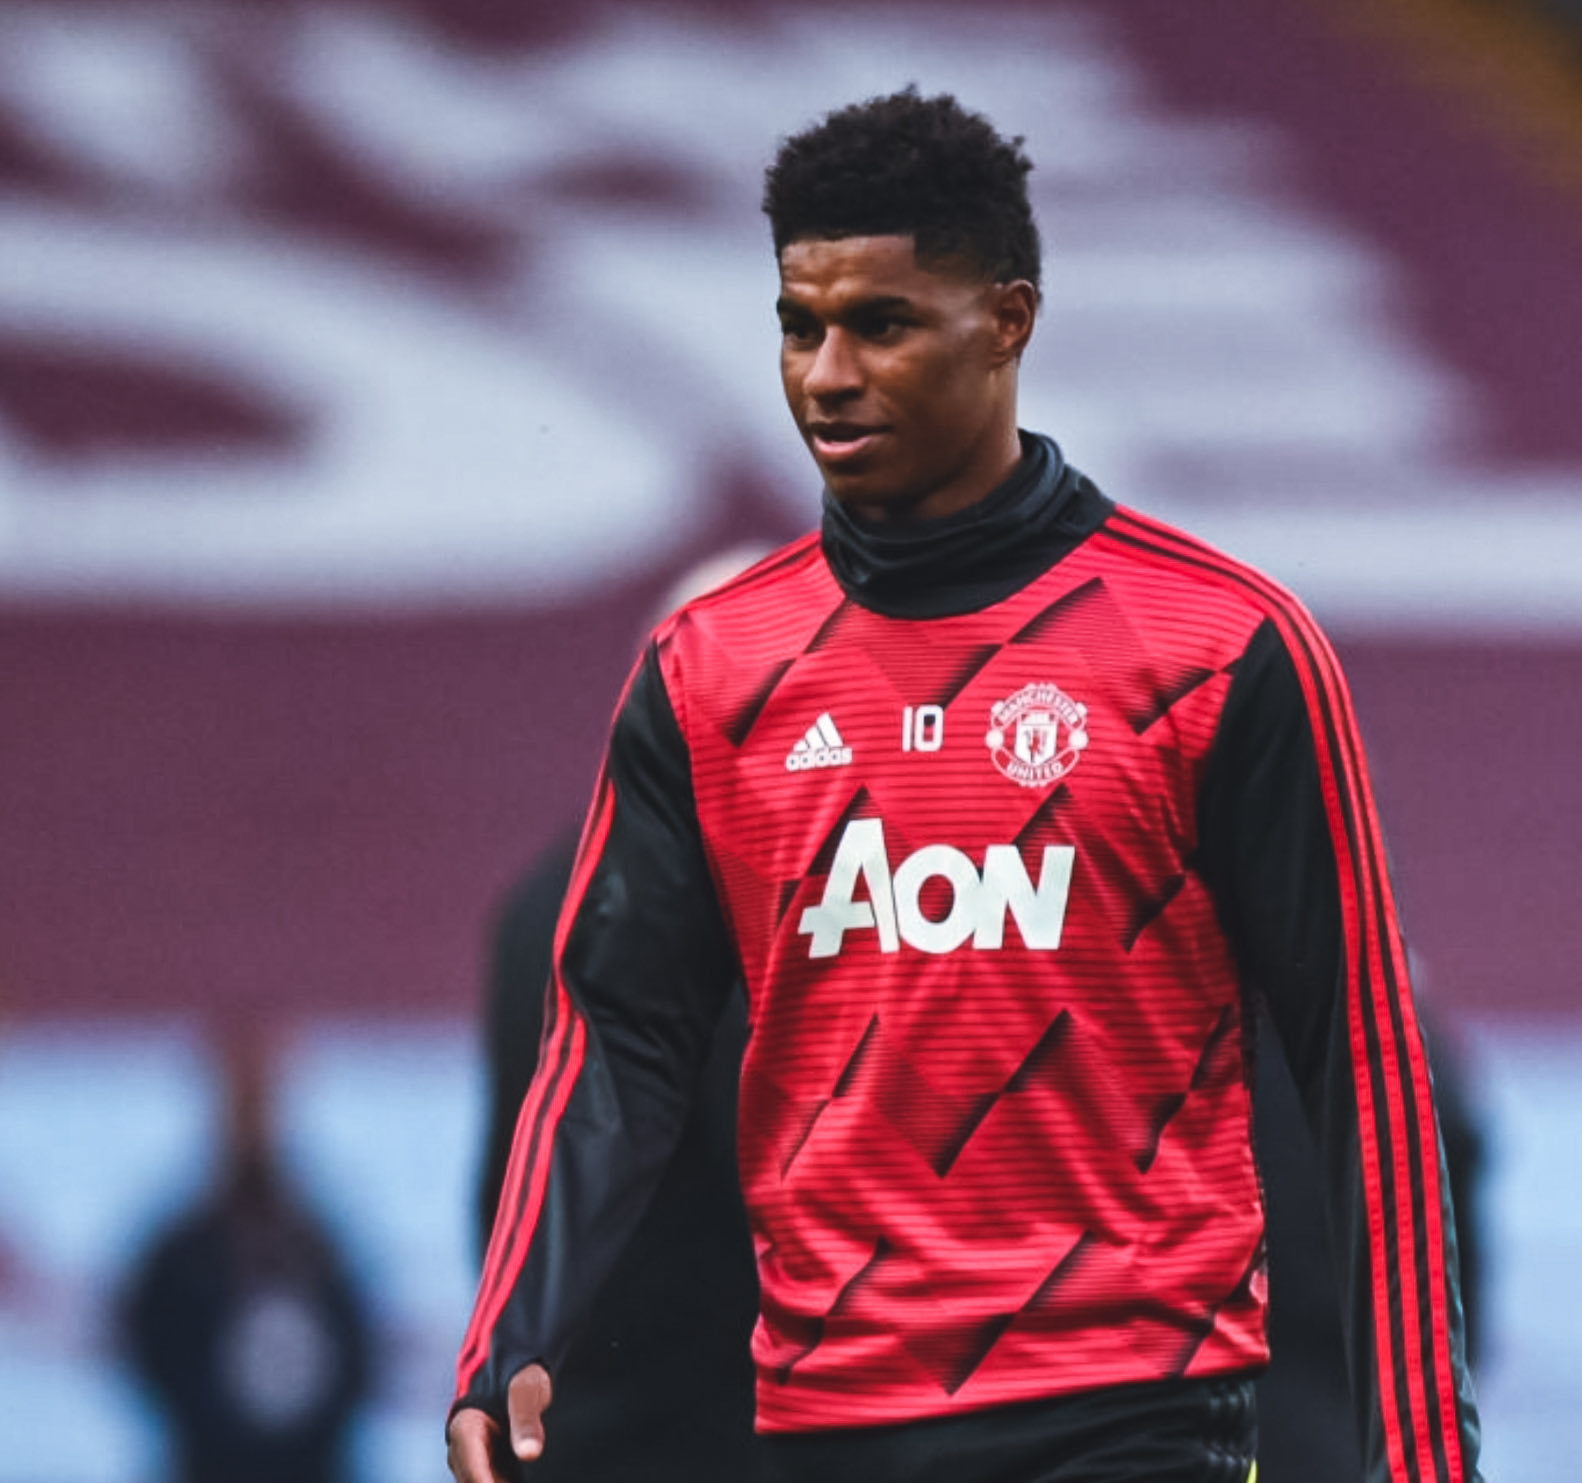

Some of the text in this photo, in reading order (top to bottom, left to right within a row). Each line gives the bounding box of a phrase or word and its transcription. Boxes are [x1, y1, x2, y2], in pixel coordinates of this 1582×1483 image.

[902, 705, 944, 751] 10
[786, 747, 853, 771] adidas
[798, 818, 1075, 958] AON
